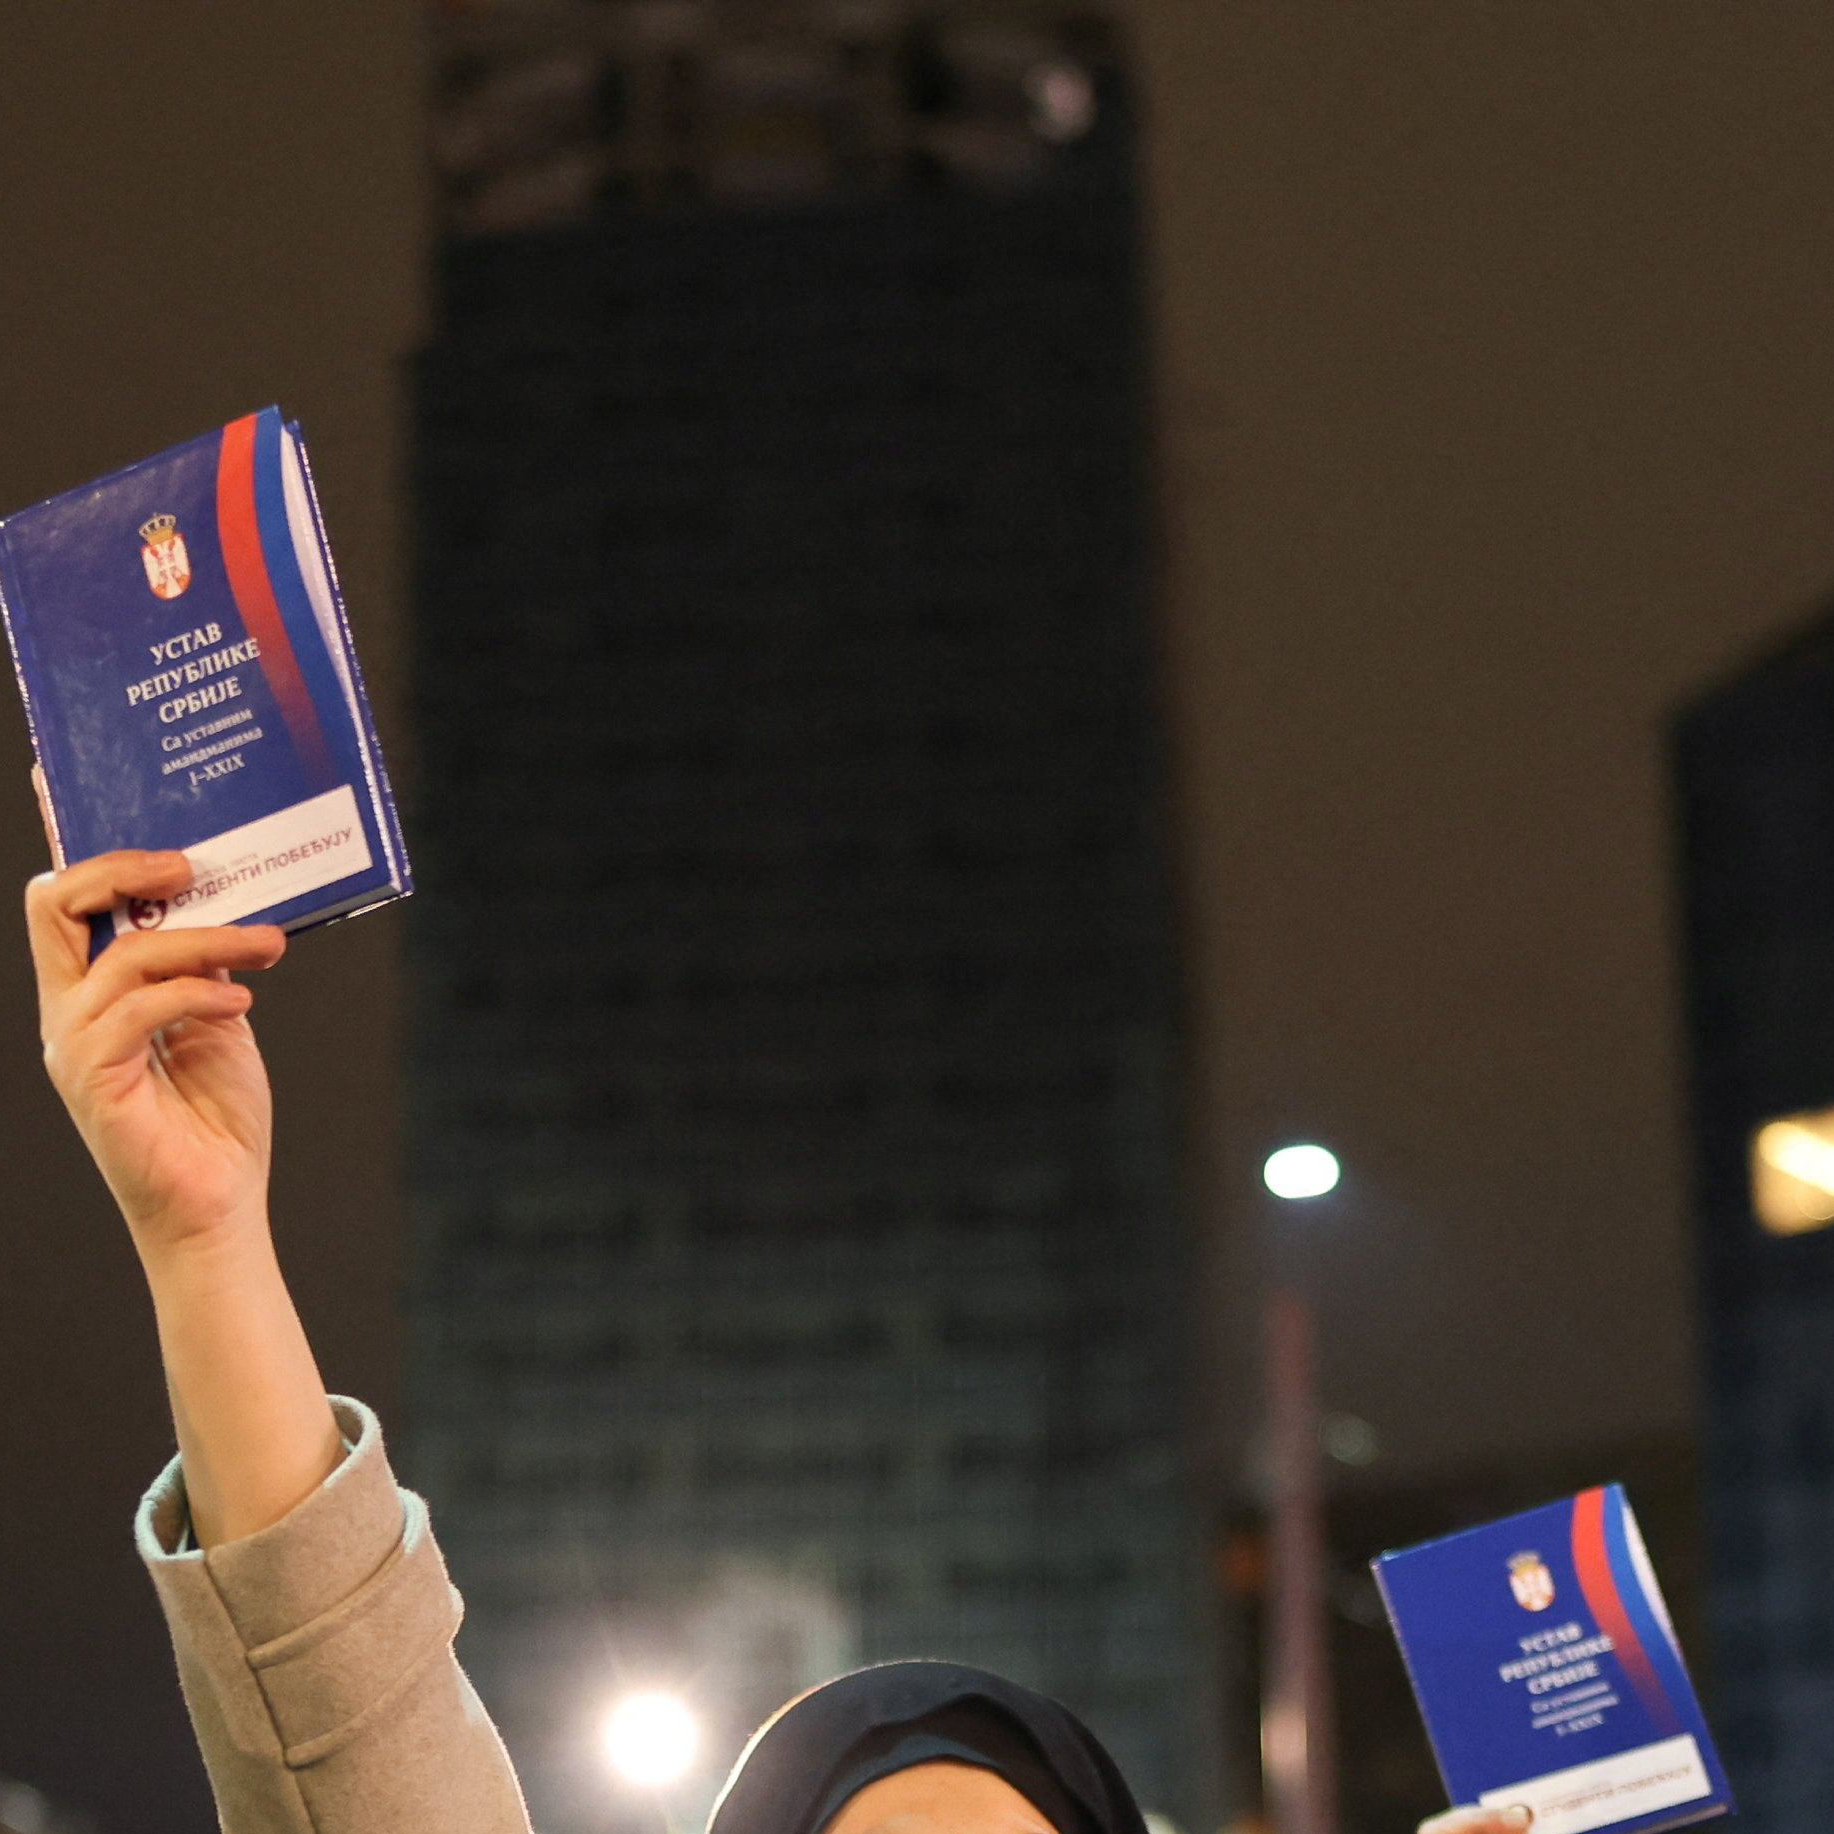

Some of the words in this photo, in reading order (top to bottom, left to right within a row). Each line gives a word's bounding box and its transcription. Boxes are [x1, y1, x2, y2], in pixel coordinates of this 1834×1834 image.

[149, 621, 223, 666] УСТАВ
[125, 637, 262, 707] РЕПУБЛИКЕ
[158, 676, 243, 724] СРБИЈЕ
[161, 733, 182, 753] Са
[174, 862, 263, 908] СТУДЕНТИ
[265, 827, 352, 874] ПОБЕЂУЈУ
